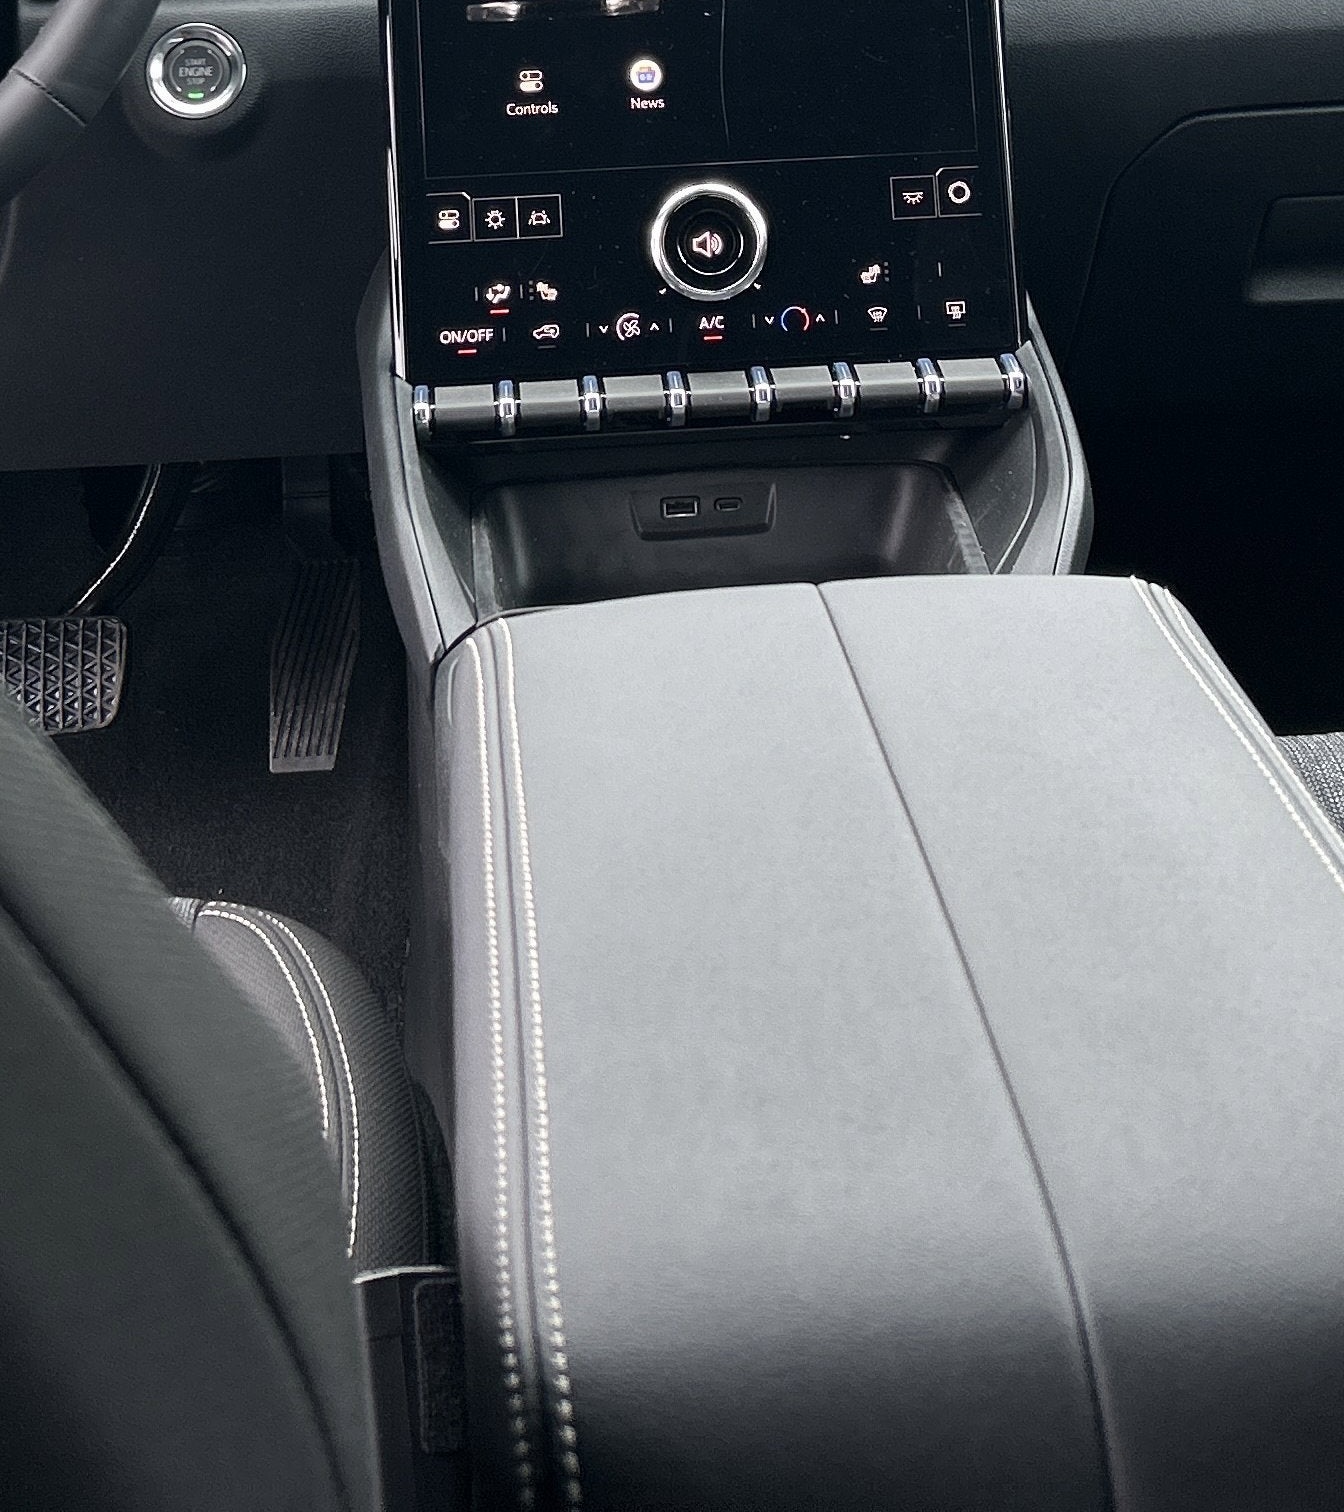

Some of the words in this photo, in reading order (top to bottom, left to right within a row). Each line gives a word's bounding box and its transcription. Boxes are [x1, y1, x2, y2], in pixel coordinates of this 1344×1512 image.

[178, 66, 214, 77] ENGINE
[506, 101, 559, 116] Controls
[630, 97, 665, 110] News
[699, 316, 725, 330] A/C
[439, 328, 494, 345] ON/OFF
